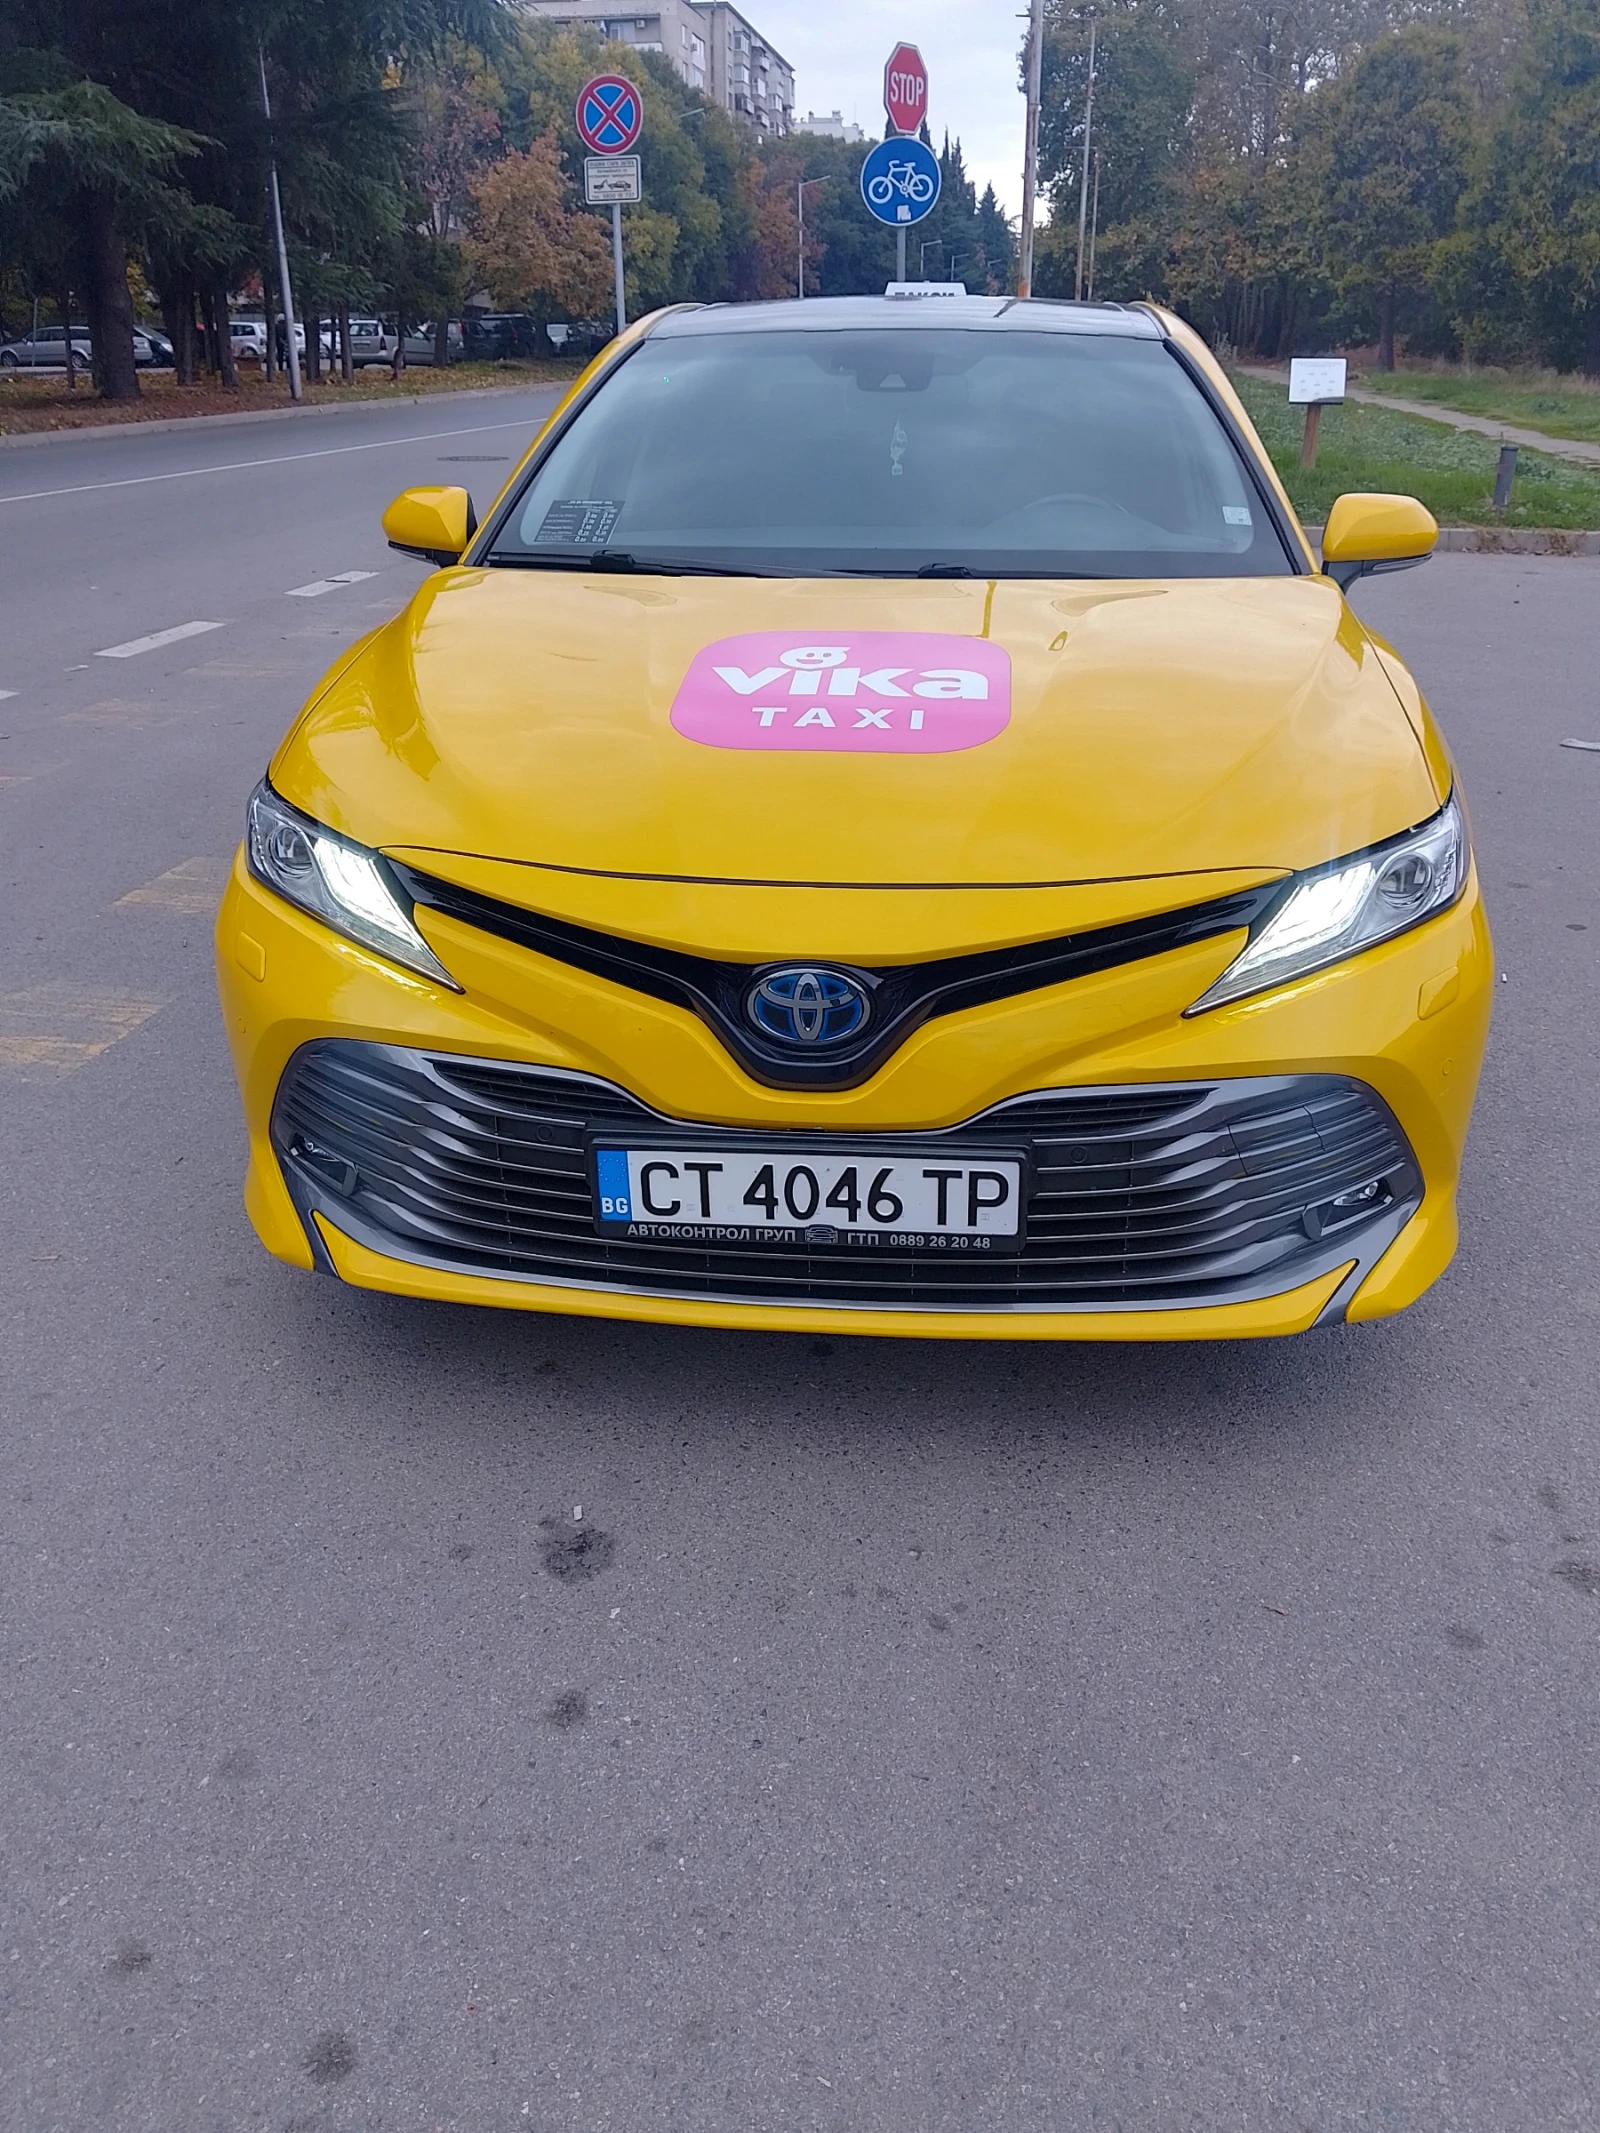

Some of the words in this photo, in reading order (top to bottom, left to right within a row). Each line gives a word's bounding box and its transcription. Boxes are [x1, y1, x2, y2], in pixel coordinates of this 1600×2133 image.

[890, 71, 925, 107] STOP
[751, 706, 925, 730] TAXI
[601, 1197, 629, 1214] BG
[640, 1160, 724, 1218] CT
[742, 1163, 904, 1223] 4046
[921, 1168, 1009, 1227] TP
[627, 1224, 749, 1240] АВТОКОНТРОЛ
[755, 1228, 796, 1242] ГРУП
[847, 1232, 879, 1245] ГТП
[889, 1234, 925, 1247] 0889
[929, 1235, 947, 1248] 26
[951, 1236, 969, 1248] 20
[972, 1237, 991, 1249] 48
